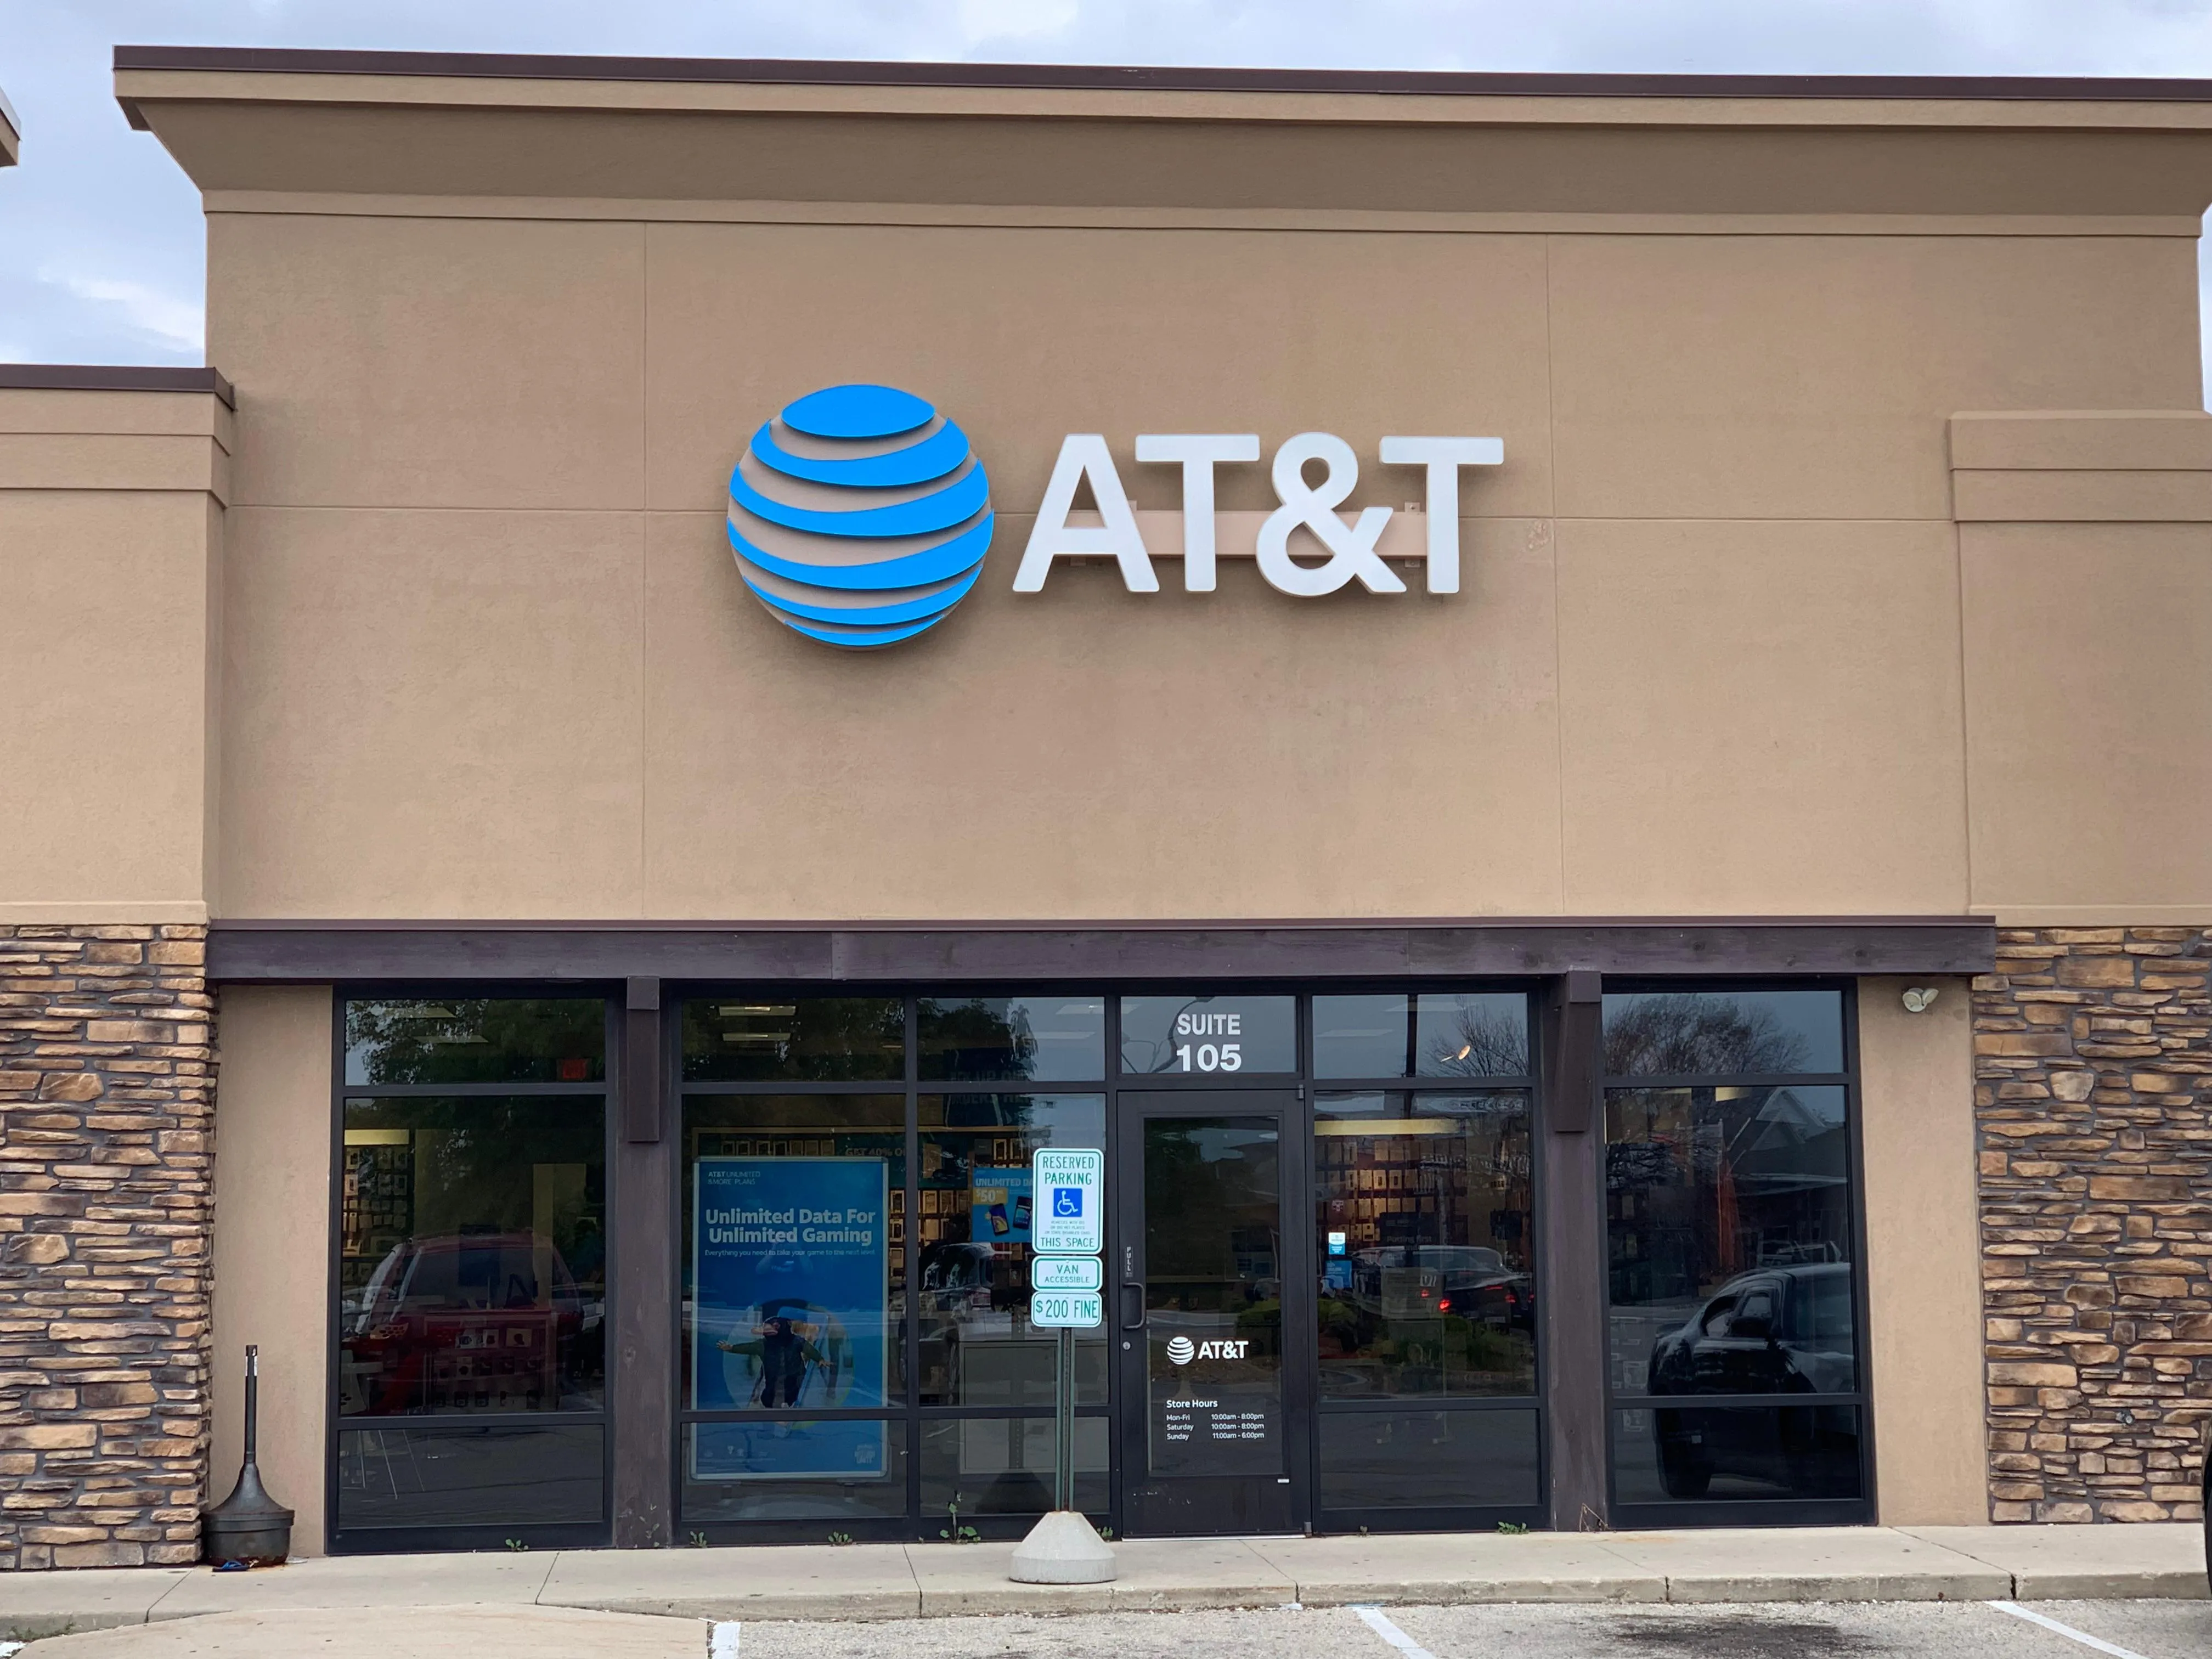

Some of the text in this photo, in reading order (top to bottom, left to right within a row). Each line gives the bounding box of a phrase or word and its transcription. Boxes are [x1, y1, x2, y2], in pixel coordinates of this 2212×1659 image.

[1012, 431, 1504, 597] AT&T
[1177, 1013, 1241, 1036] SUITE
[1176, 1043, 1242, 1072] 105
[1043, 1155, 1094, 1169] RESERVED
[975, 1178, 1022, 1187] UNLIMITED
[1045, 1172, 1092, 1186] PARKING
[706, 1208, 876, 1224] Unlimited Data For
[709, 1227, 872, 1246] Unlimited Gaming
[1040, 1237, 1095, 1248] THIS SPACE
[1056, 1265, 1079, 1274] VAN
[1074, 1300, 1098, 1318] FINE
[1198, 1341, 1249, 1359] AT&T
[1166, 1400, 1218, 1408] Store Hours
